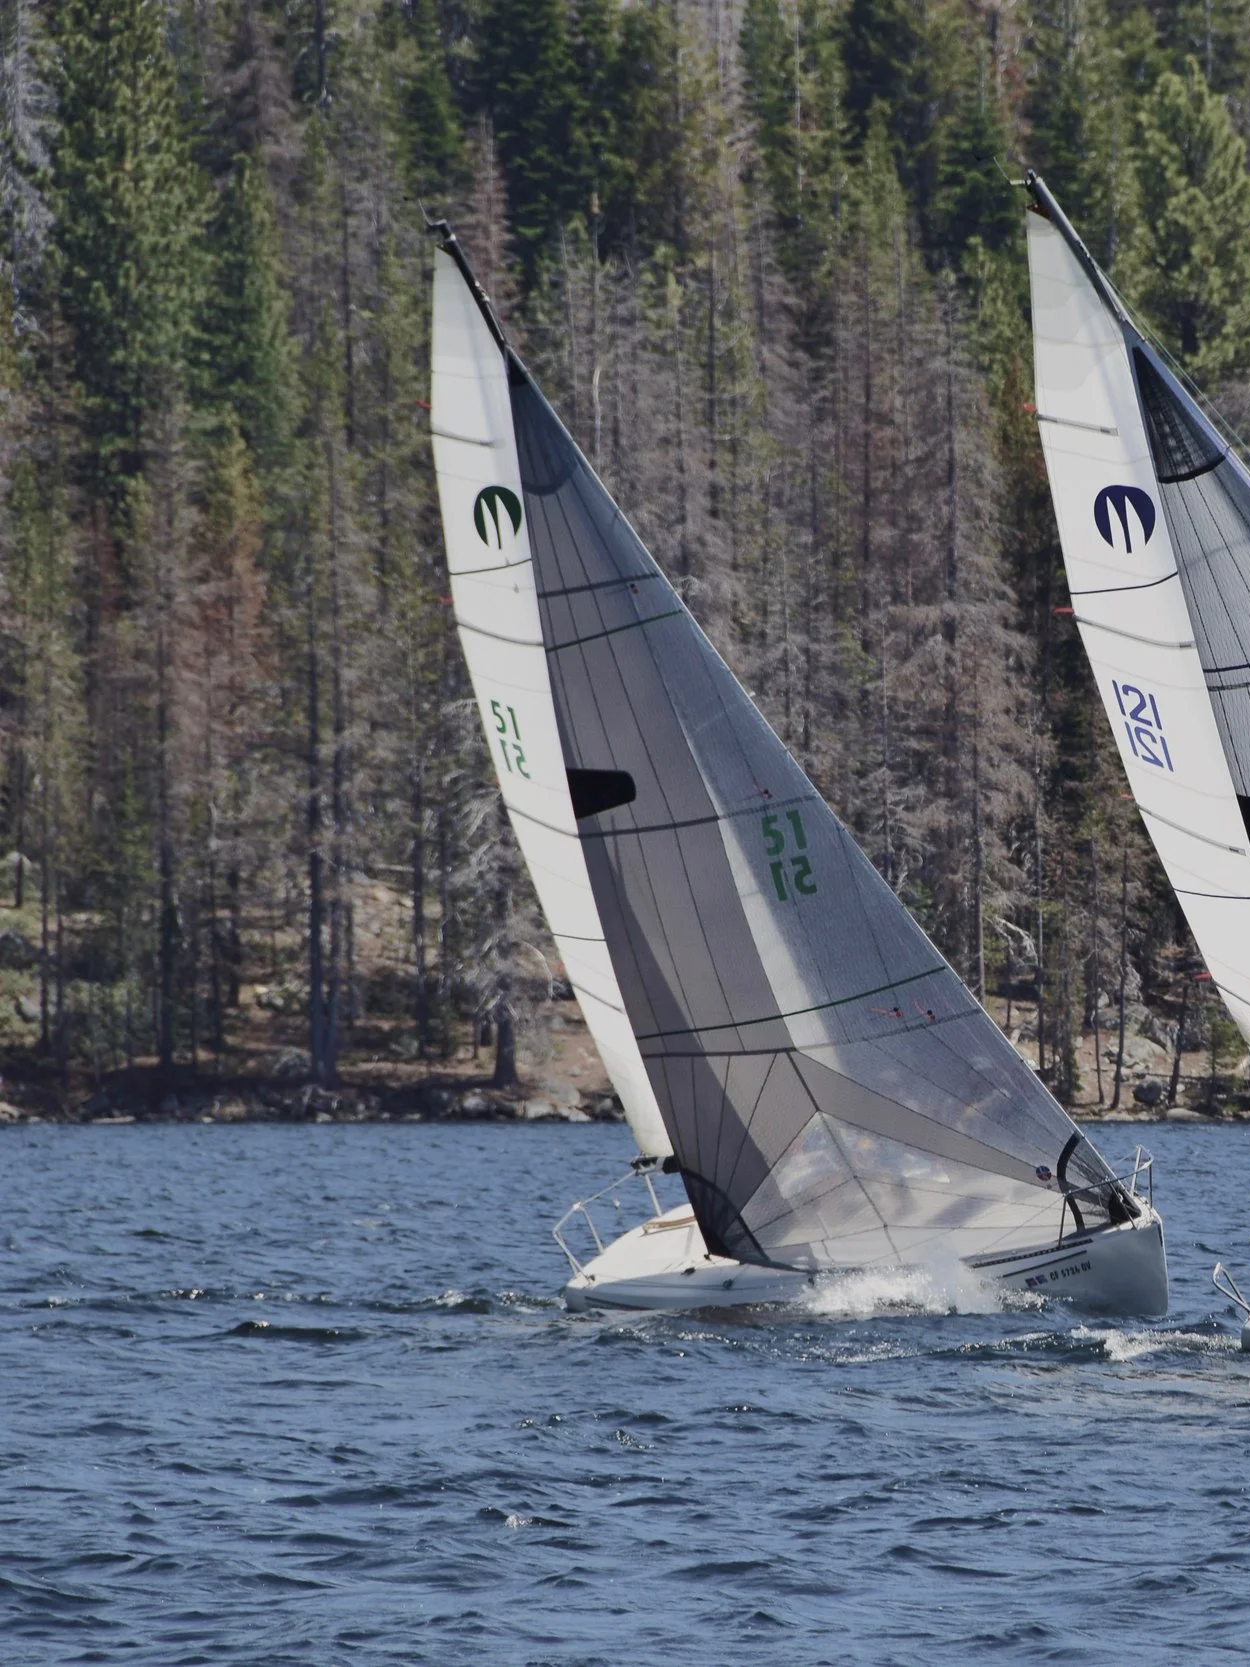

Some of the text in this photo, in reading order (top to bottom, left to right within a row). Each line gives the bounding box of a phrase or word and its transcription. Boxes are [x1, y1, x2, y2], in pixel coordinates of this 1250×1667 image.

[490, 700, 521, 741] 51
[1112, 680, 1163, 731] 121
[760, 810, 807, 856] 51
[1049, 1270, 1059, 1281] CF
